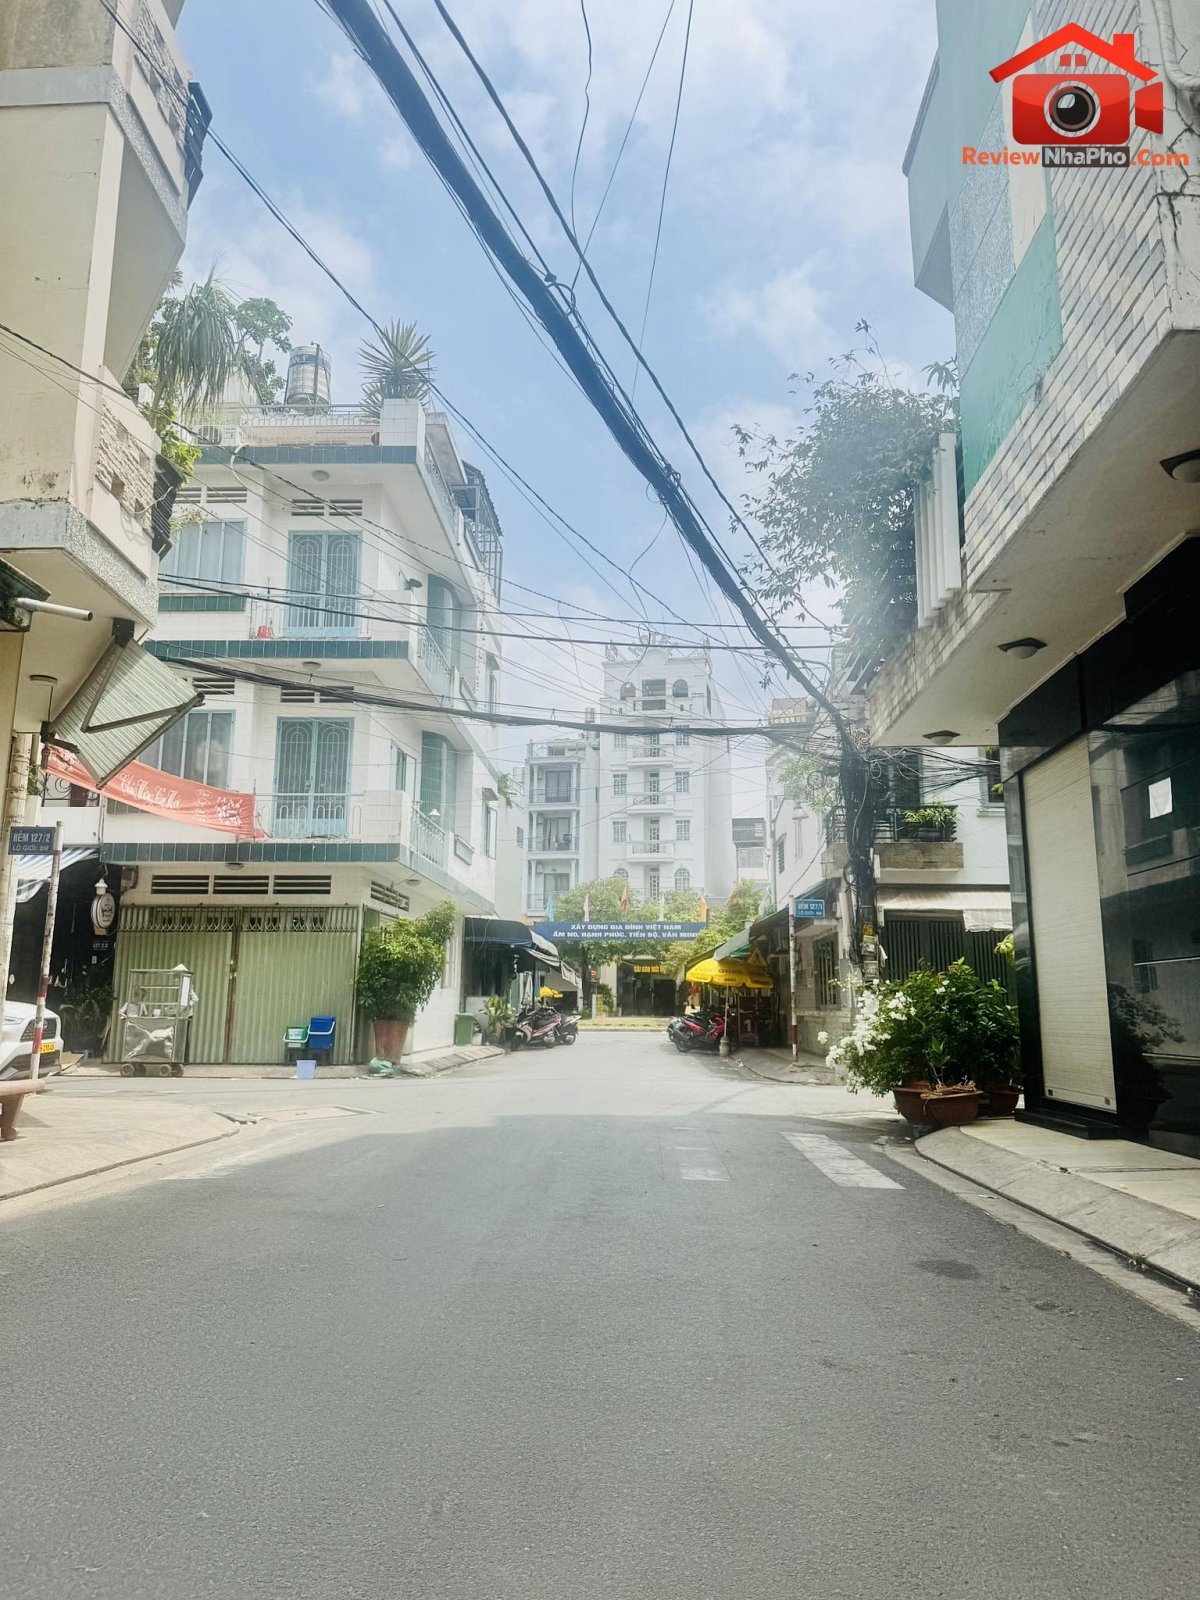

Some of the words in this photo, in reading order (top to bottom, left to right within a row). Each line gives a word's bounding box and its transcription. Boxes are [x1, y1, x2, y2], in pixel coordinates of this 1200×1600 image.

[31, 833, 51, 843] 127/2
[645, 923, 662, 931] VIỆT
[553, 930, 566, 938] ẤM
[628, 930, 646, 938] TIẾN
[662, 930, 678, 938] VĂN
